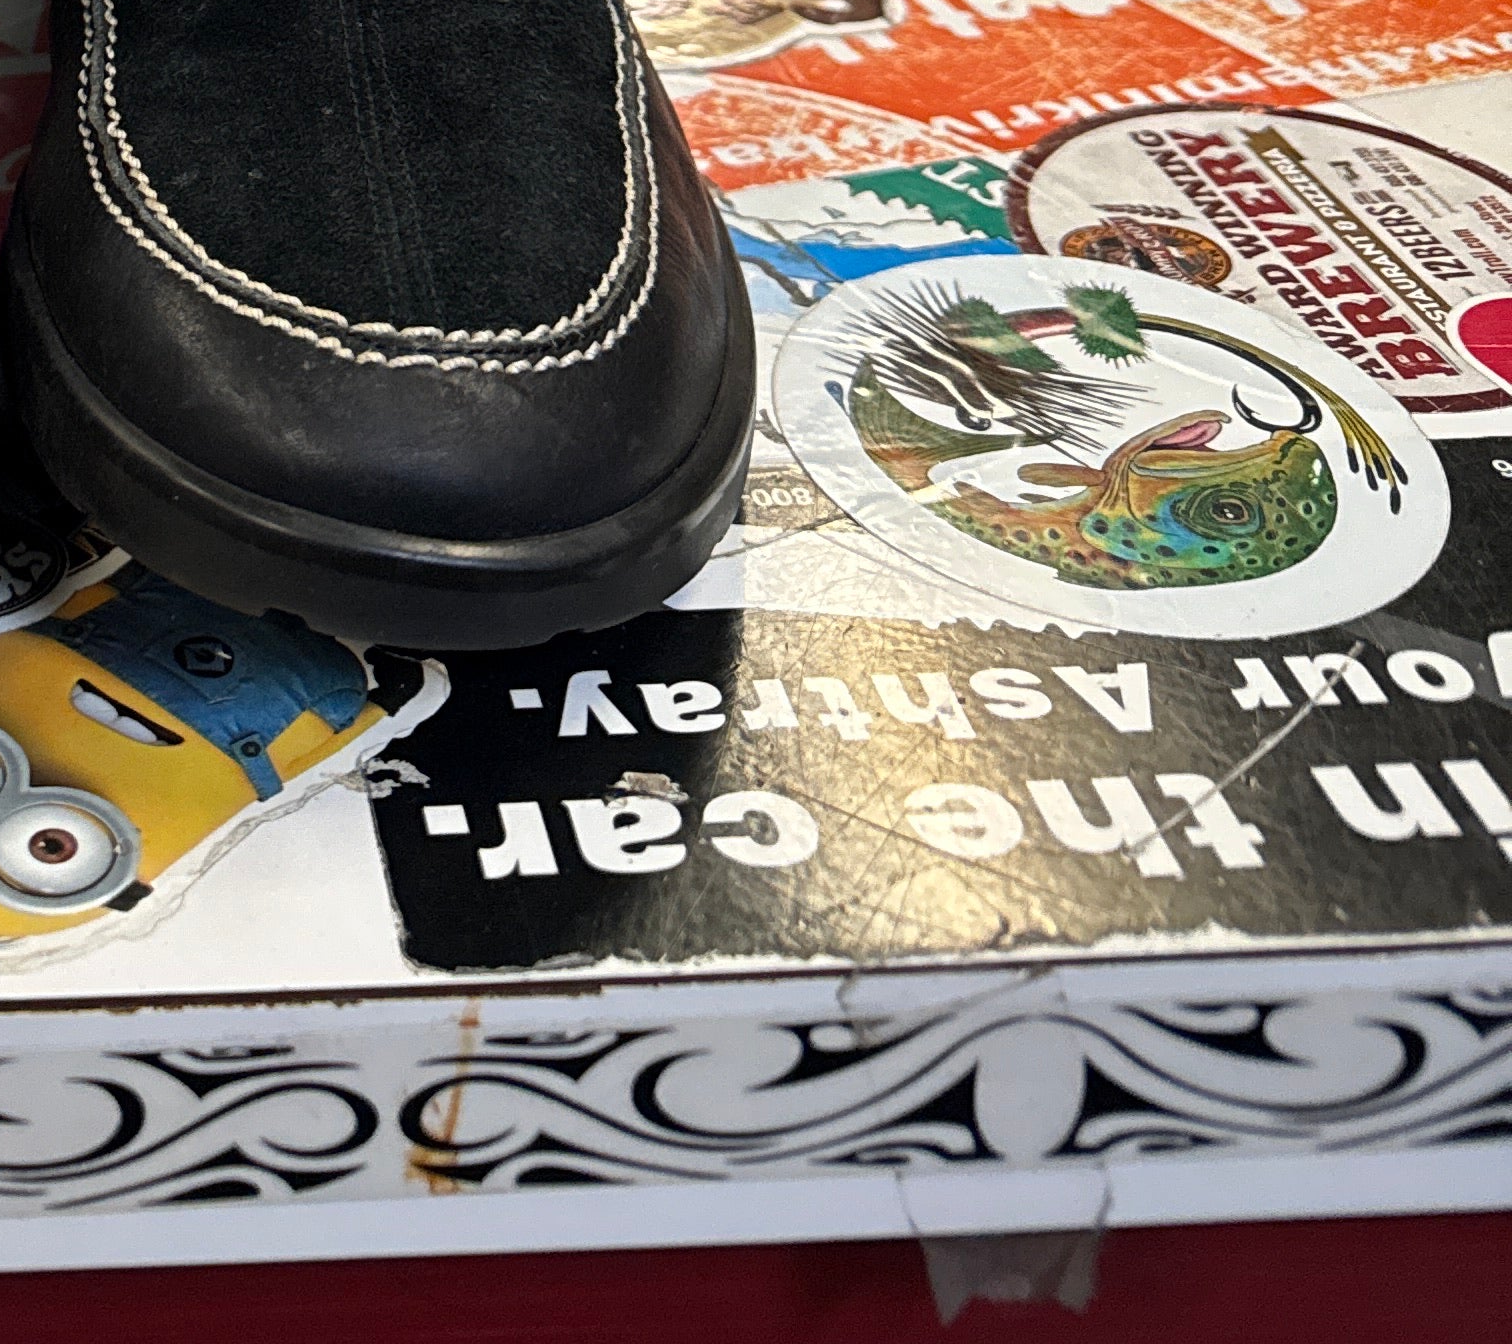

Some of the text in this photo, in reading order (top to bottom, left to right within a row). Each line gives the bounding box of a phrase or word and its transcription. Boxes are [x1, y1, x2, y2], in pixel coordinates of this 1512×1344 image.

[1263, 144, 1343, 218] PIZZERIA
[1130, 130, 1395, 383] AWARD WINNING
[1169, 126, 1462, 382] BREWERY
[509, 661, 1153, 742] Ashtray.
[420, 789, 819, 882] car.
[904, 770, 1266, 880] the
